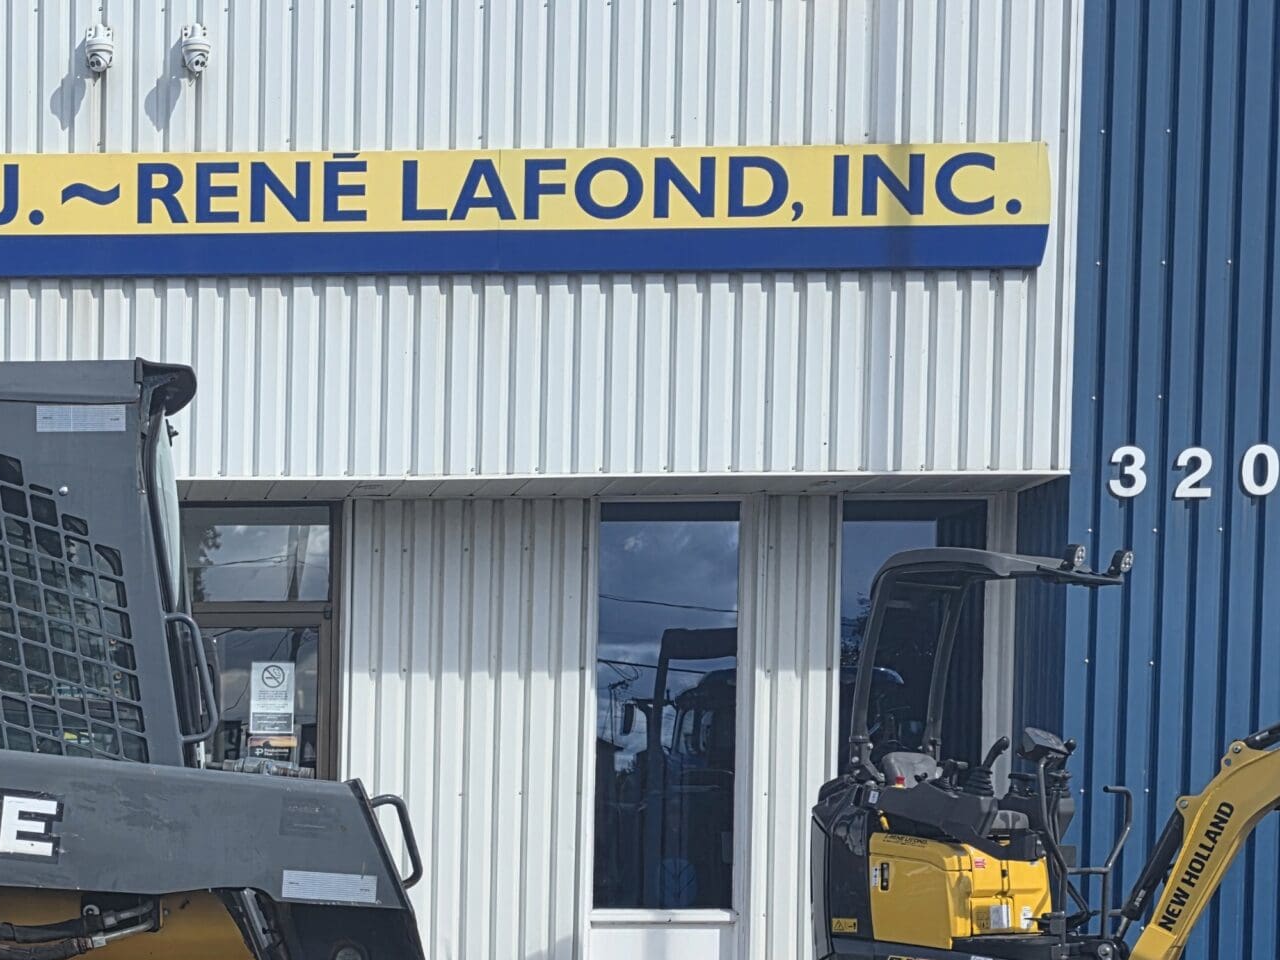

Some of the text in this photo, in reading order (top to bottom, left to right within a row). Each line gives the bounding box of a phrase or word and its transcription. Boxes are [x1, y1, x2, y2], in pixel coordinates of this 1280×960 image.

[402, 155, 805, 221] LAFOND,
[832, 152, 1023, 217] INC.
[1158, 801, 1235, 932] NEW HOLLAND
